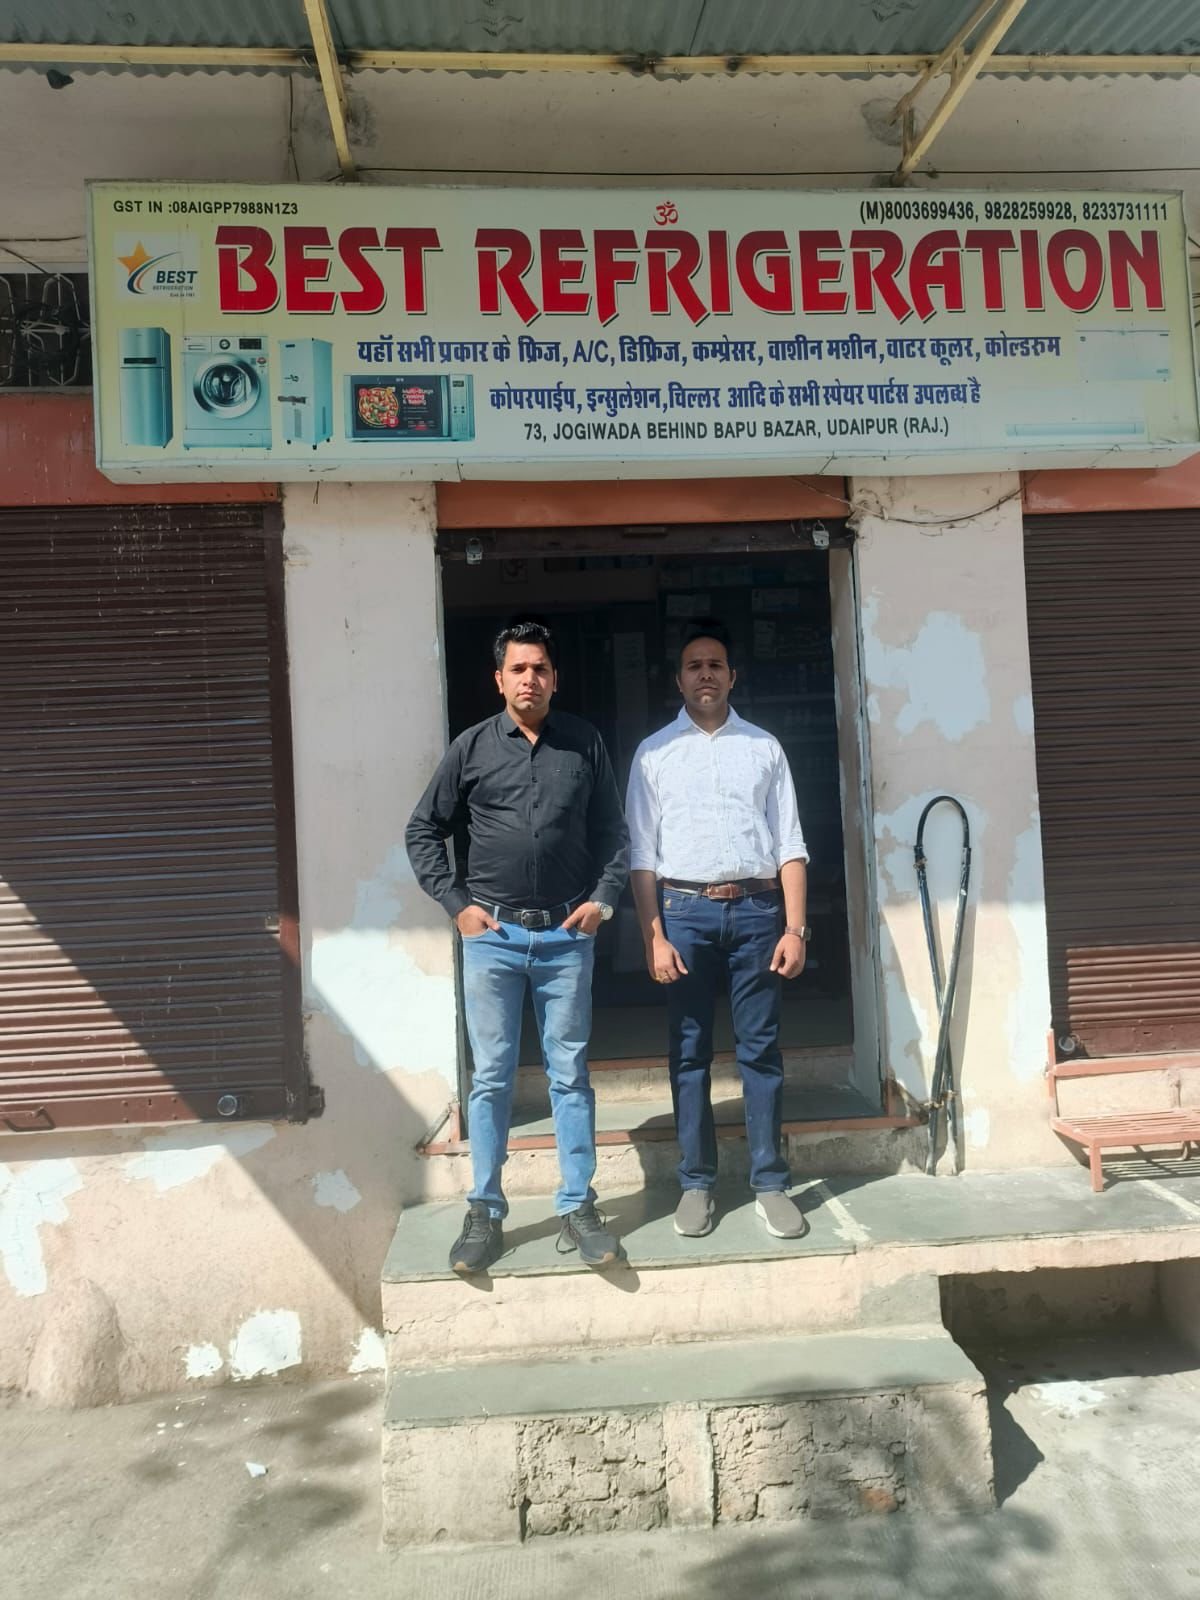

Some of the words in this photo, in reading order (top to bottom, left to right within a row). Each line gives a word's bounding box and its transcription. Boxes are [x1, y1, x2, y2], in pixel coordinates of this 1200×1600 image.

[113, 199, 143, 213] GST
[148, 200, 163, 213] IN
[859, 200, 979, 225] (M)8003699436,
[984, 200, 1077, 224] 9828259928,
[1082, 201, 1167, 221] 8233731111
[155, 270, 199, 284] BEST
[214, 225, 444, 316] BEST
[474, 227, 1167, 327] REFRIGERATION
[396, 334, 437, 363] सभी
[437, 341, 490, 364] प्रकार
[491, 334, 512, 363] के
[572, 339, 616, 367] A/C,
[691, 333, 764, 367] कम्प्रेसर,
[767, 333, 824, 362] वाशीन
[825, 332, 885, 364] मशीन,
[885, 338, 927, 359] वाटर
[928, 337, 981, 366] कूलर,
[488, 380, 583, 415] कोपरपाईप,
[585, 380, 668, 418] इन्सुलेशन,
[669, 381, 721, 409] चिल्लर
[727, 380, 767, 408] आदि
[767, 379, 786, 408] के
[787, 379, 821, 407] सभी
[821, 378, 865, 406] स्पेयर
[912, 383, 968, 405] उपलब्ध
[967, 376, 982, 404] है
[523, 422, 547, 443] 73,
[552, 422, 642, 441] JOGIWADA
[646, 421, 708, 440] BEHIND
[713, 420, 757, 439] BAPU
[763, 419, 822, 439] BAZAR,
[826, 417, 899, 436] UDAIPUR
[903, 416, 949, 439] (RAJ.)
